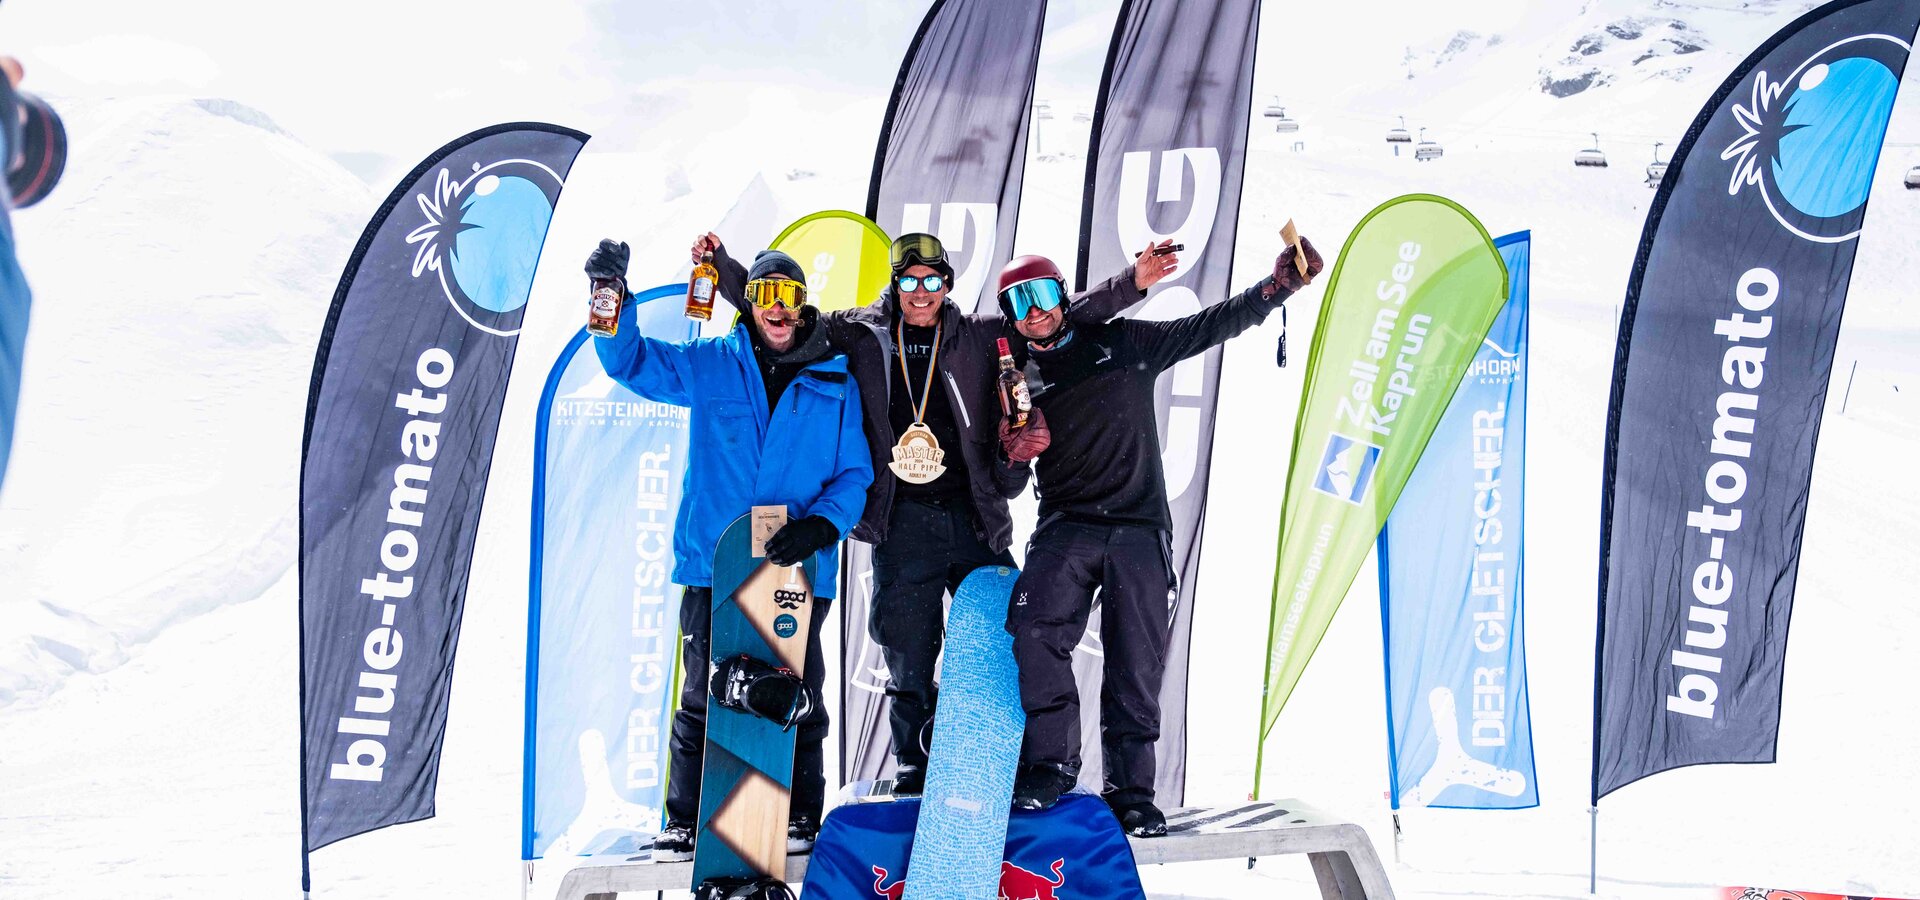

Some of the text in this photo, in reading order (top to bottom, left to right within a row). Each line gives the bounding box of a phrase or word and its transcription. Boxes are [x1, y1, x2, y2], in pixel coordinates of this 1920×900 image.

[1336, 241, 1421, 427] Zell am See
[1367, 312, 1432, 436] Kaprun
[557, 401, 689, 420] KITZSTEINHORN
[895, 447, 942, 463] MASTER
[898, 463, 938, 473] HALF PIPE
[1667, 267, 1781, 719] blue-tomato
[330, 347, 454, 782] blue-tomato
[774, 590, 807, 603] good
[777, 622, 793, 630] good
[628, 705, 661, 789] DER
[1472, 666, 1506, 747] DER
